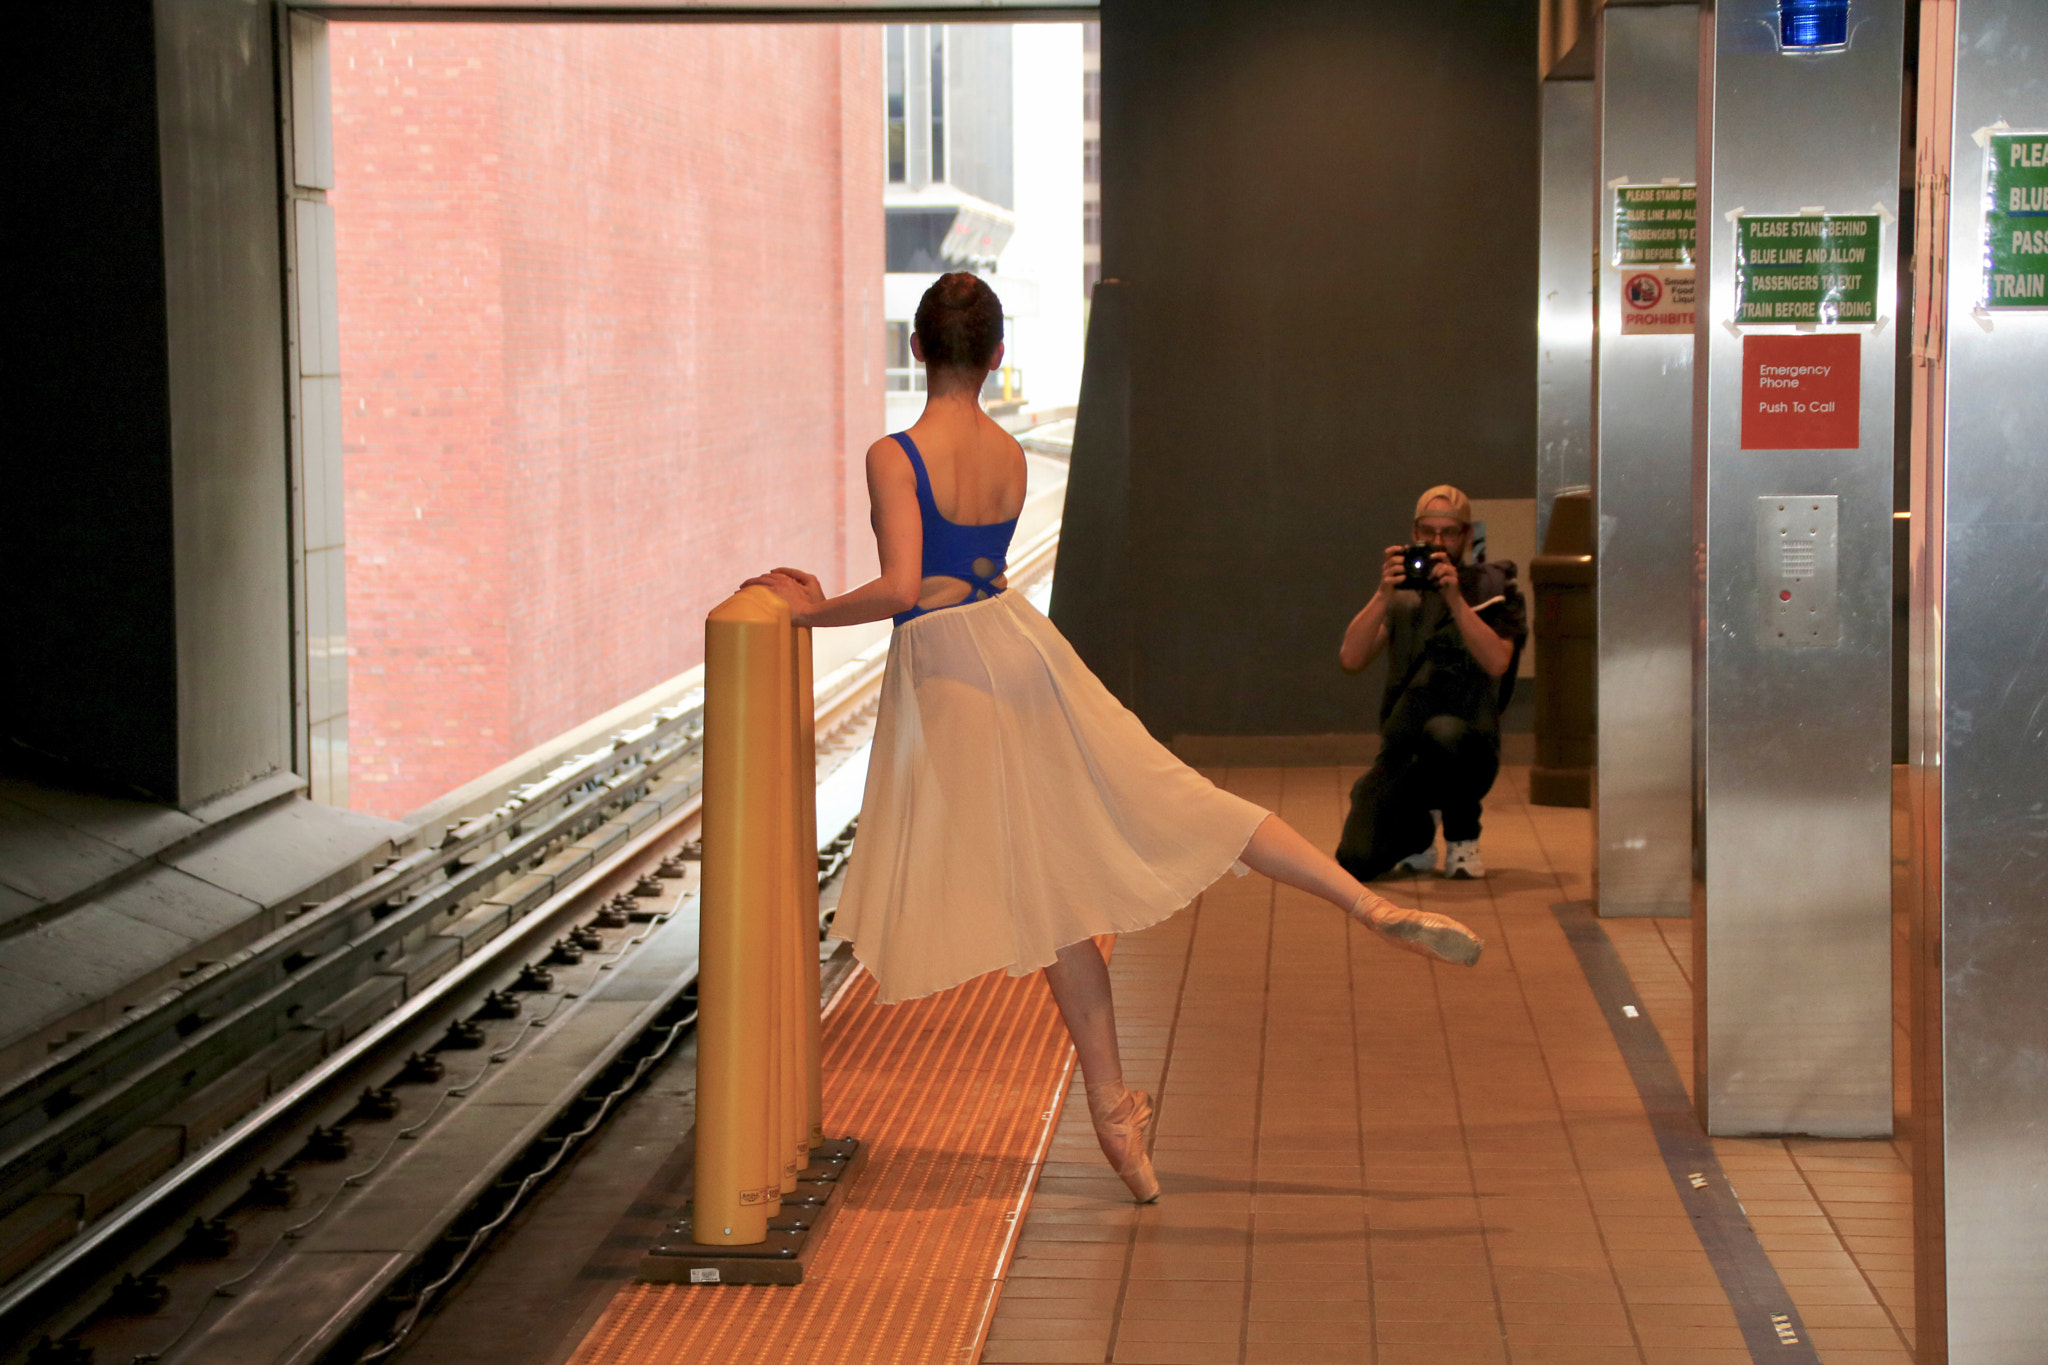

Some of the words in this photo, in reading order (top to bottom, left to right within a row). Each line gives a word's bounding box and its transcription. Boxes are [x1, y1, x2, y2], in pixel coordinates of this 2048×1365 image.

[2011, 143, 2048, 167] PLEA
[1626, 189, 1654, 201] PLEASE
[1656, 189, 1680, 200] STAND
[2010, 187, 2048, 211] BLUE
[1627, 209, 1646, 220] BLUE
[1648, 209, 1664, 220] LINE
[1666, 208, 1682, 220] AND
[1628, 229, 1676, 240] PASSENGERS
[1678, 228, 1688, 239] TO
[1751, 222, 1789, 237] PLEASE
[1792, 222, 1826, 237] STAND
[1829, 221, 1867, 236] BEHIND
[1645, 248, 1674, 259] BEFORE
[1751, 249, 1776, 264] BLUE
[1779, 248, 1803, 264] LINE
[1805, 249, 1827, 263] AND
[1830, 248, 1865, 263] ALLOW
[1752, 275, 1818, 291] PASSENGERS
[1821, 275, 1836, 290] TO
[1838, 275, 1862, 289] EXIT
[1994, 273, 2045, 297] TRAIN
[1742, 302, 1772, 318] TRAIN
[1775, 302, 1815, 317] BEFORE
[1818, 301, 1872, 316] ARDING
[1760, 364, 1831, 377] Emergency
[1760, 377, 1799, 388] Phone
[1760, 402, 1788, 413] Push
[1793, 402, 1806, 412] To
[1809, 401, 1835, 412] Call
